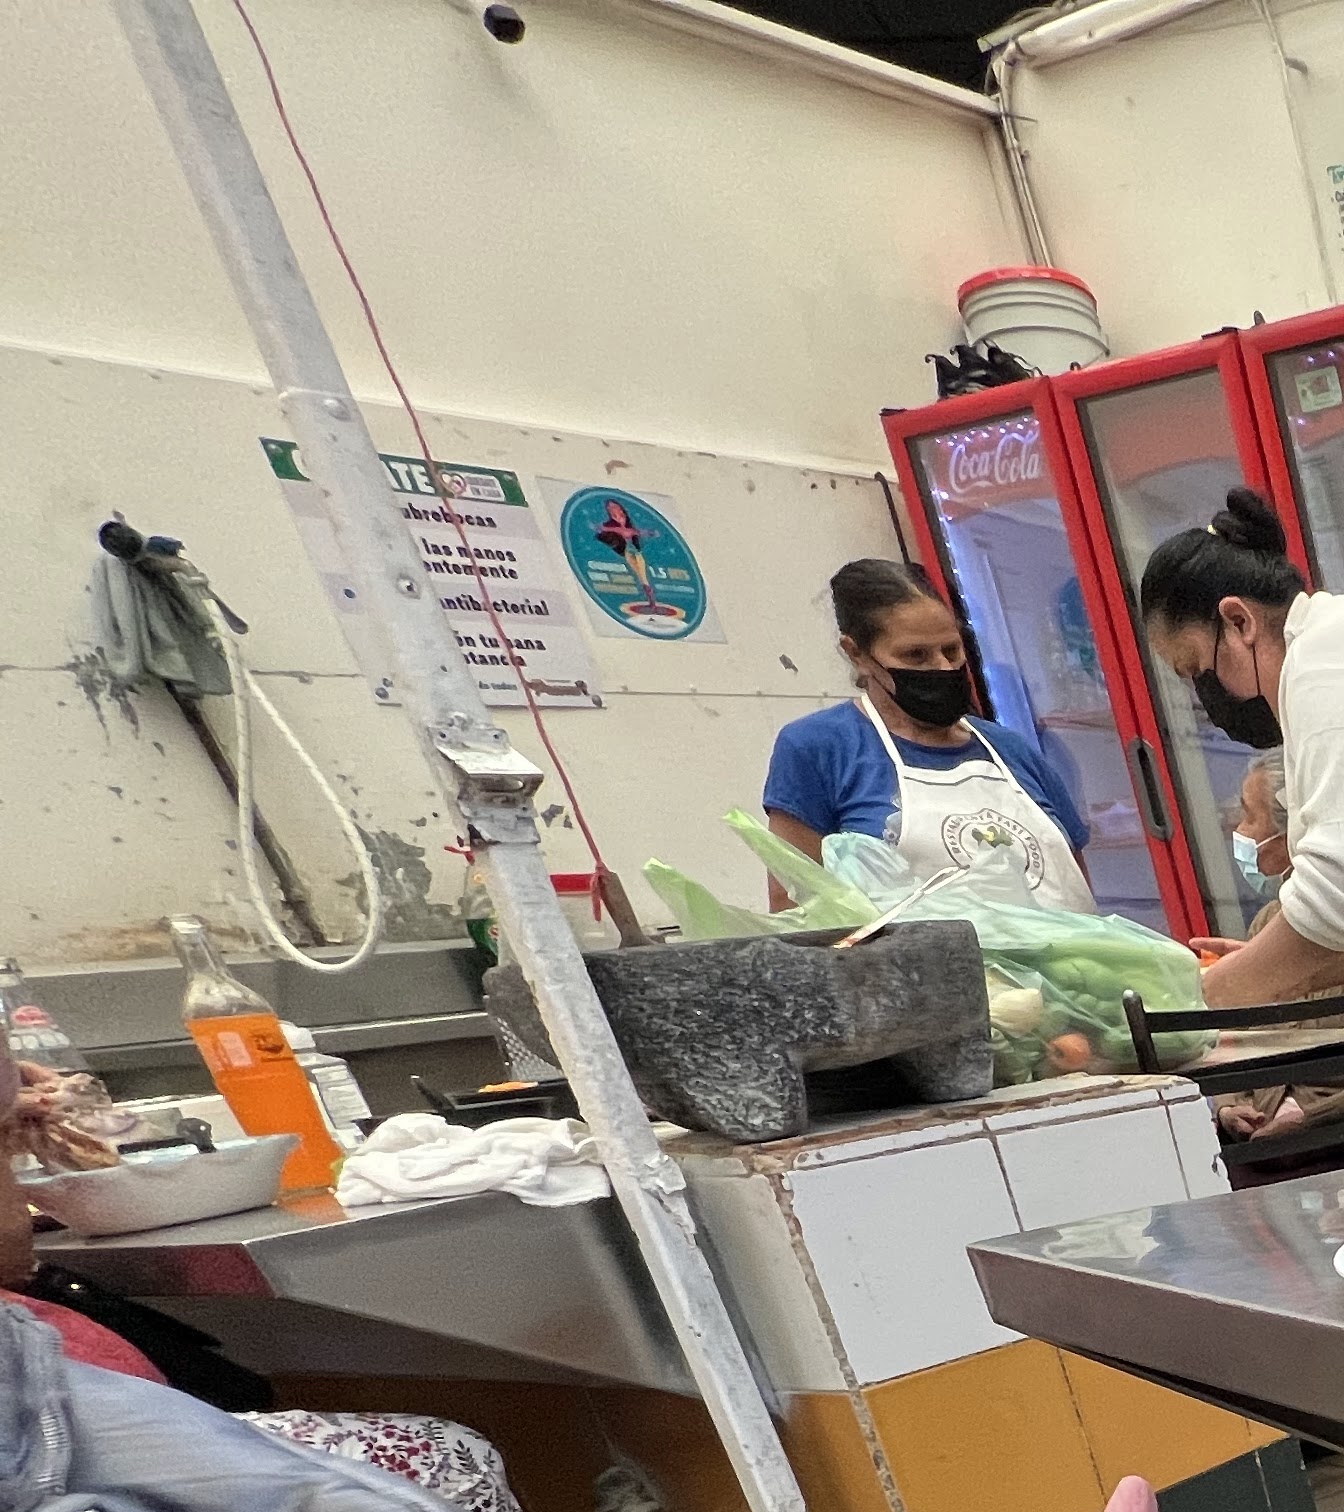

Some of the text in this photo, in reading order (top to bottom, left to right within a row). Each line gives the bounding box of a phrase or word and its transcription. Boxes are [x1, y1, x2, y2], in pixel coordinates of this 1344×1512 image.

[401, 502, 497, 528] ubrebocas
[421, 537, 517, 563] las manos
[441, 594, 550, 616] ntibcterial
[479, 633, 500, 648] tu
